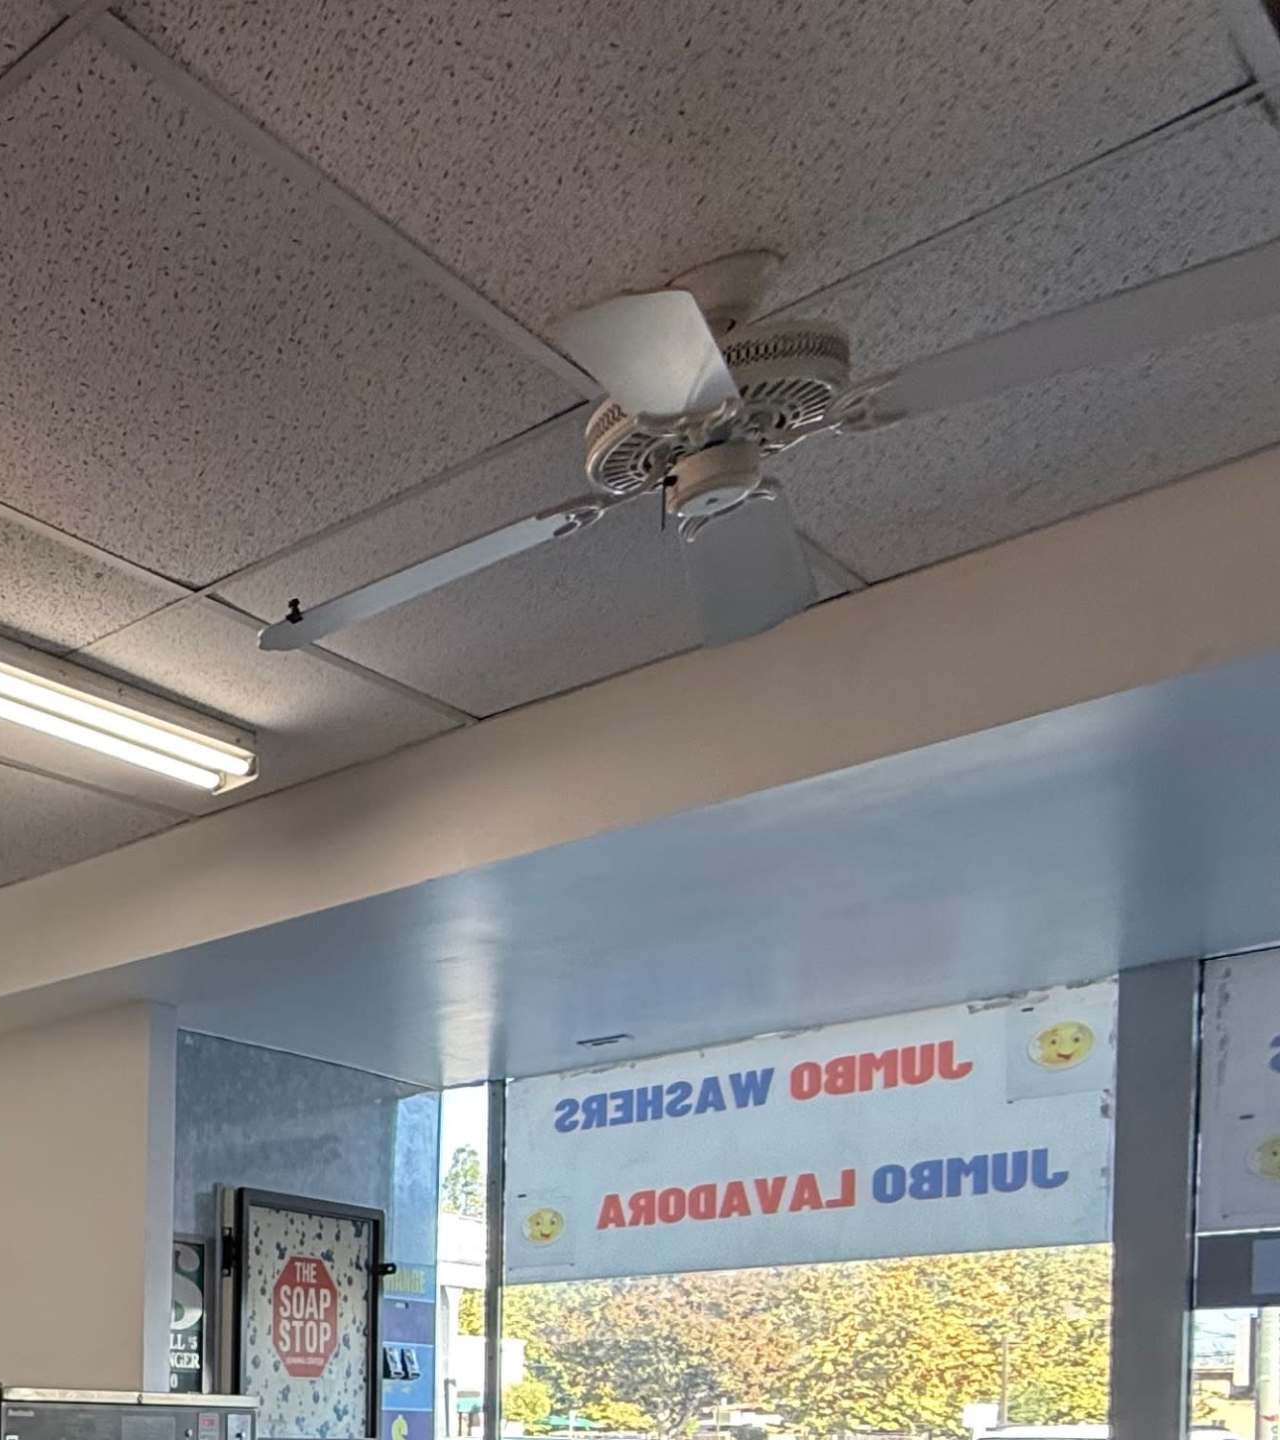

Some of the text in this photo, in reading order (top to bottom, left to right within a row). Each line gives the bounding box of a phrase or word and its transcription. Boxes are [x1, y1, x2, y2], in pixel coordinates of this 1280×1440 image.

[294, 1261, 317, 1283] THE
[278, 1285, 331, 1320] SOAP
[278, 1319, 331, 1355] STOP
